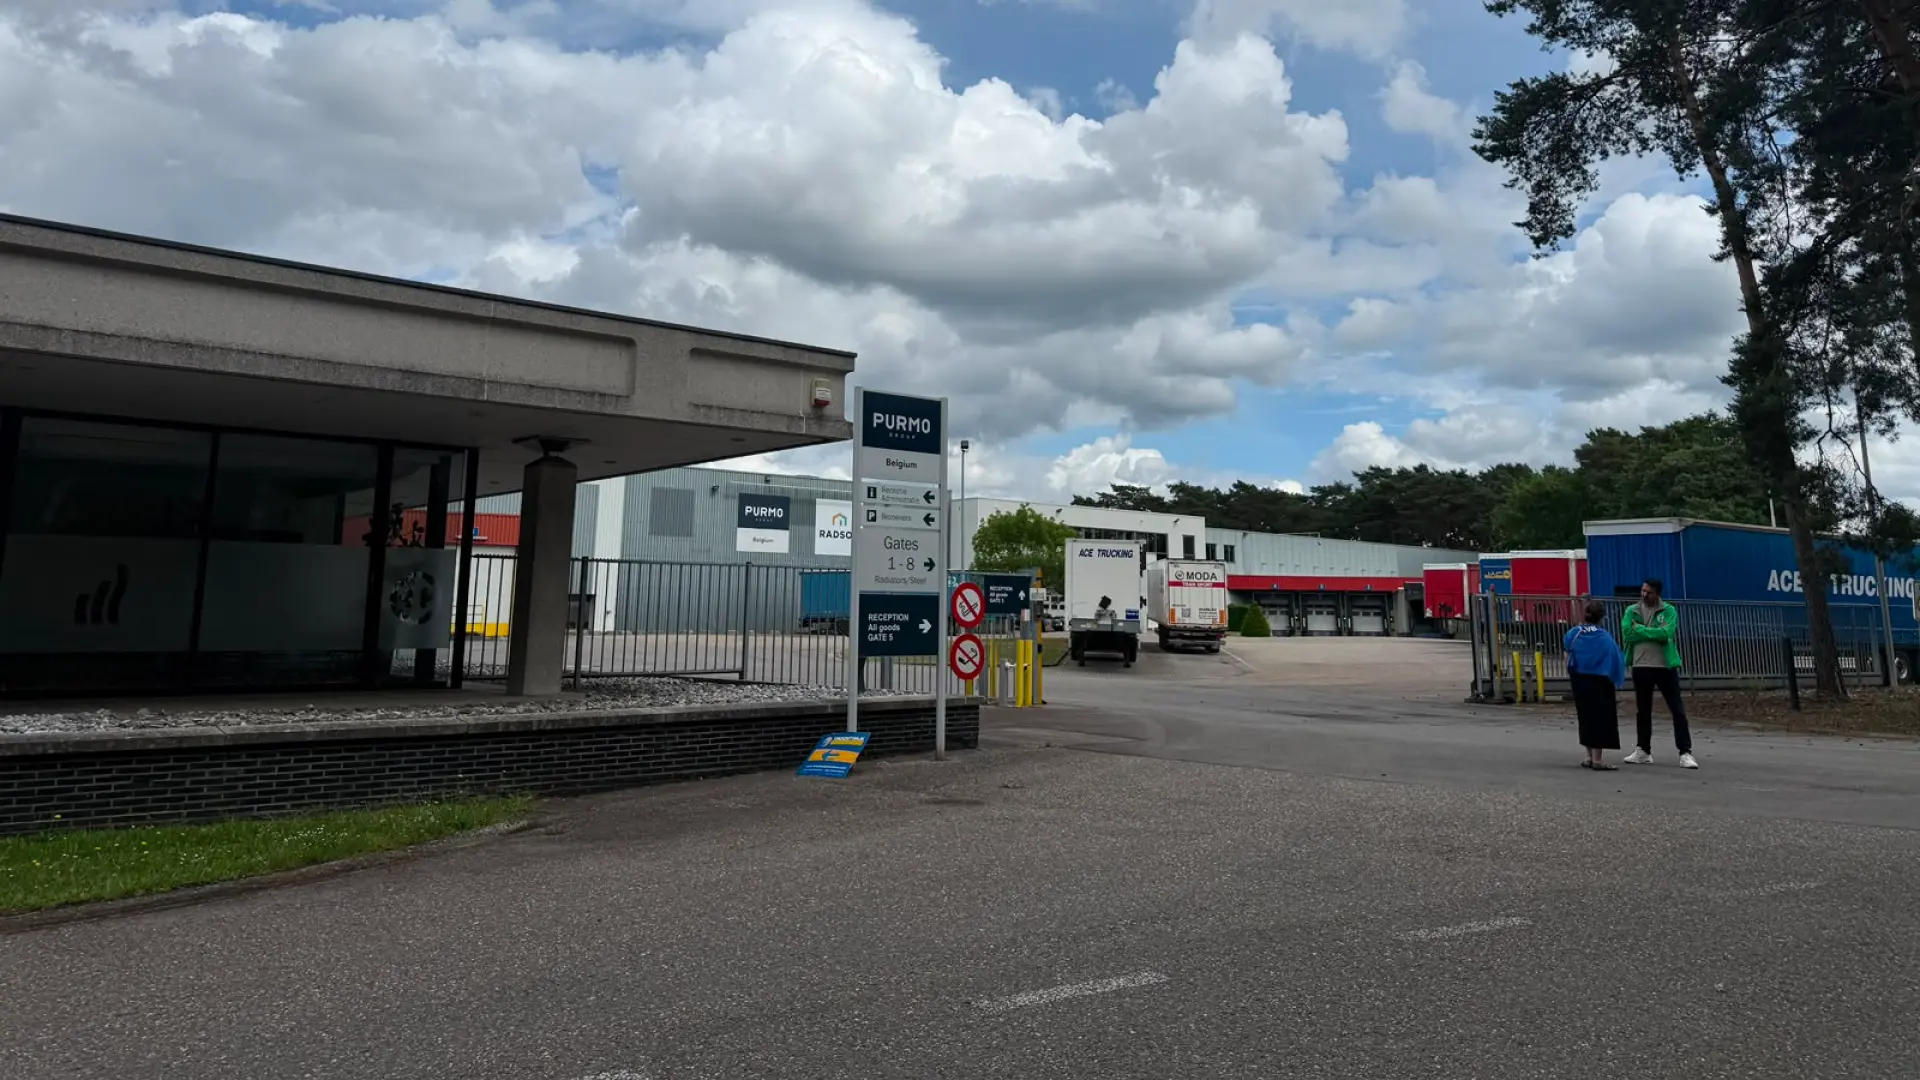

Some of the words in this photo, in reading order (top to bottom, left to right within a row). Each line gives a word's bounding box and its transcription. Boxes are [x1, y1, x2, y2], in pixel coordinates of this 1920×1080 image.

[873, 412, 931, 434] PURMO
[886, 458, 918, 470] Belgium
[744, 505, 784, 518] PURMO
[883, 535, 919, 551] Gates
[1078, 548, 1094, 558] ACE
[1097, 549, 1134, 559] TRUCKING
[1186, 571, 1218, 581] MODA
[1767, 569, 1804, 593] ACE
[868, 613, 909, 622] RECEPTION
[868, 623, 878, 631] All
[879, 623, 901, 633] goods
[867, 633, 888, 642] GATE
[888, 633, 894, 641] 5
